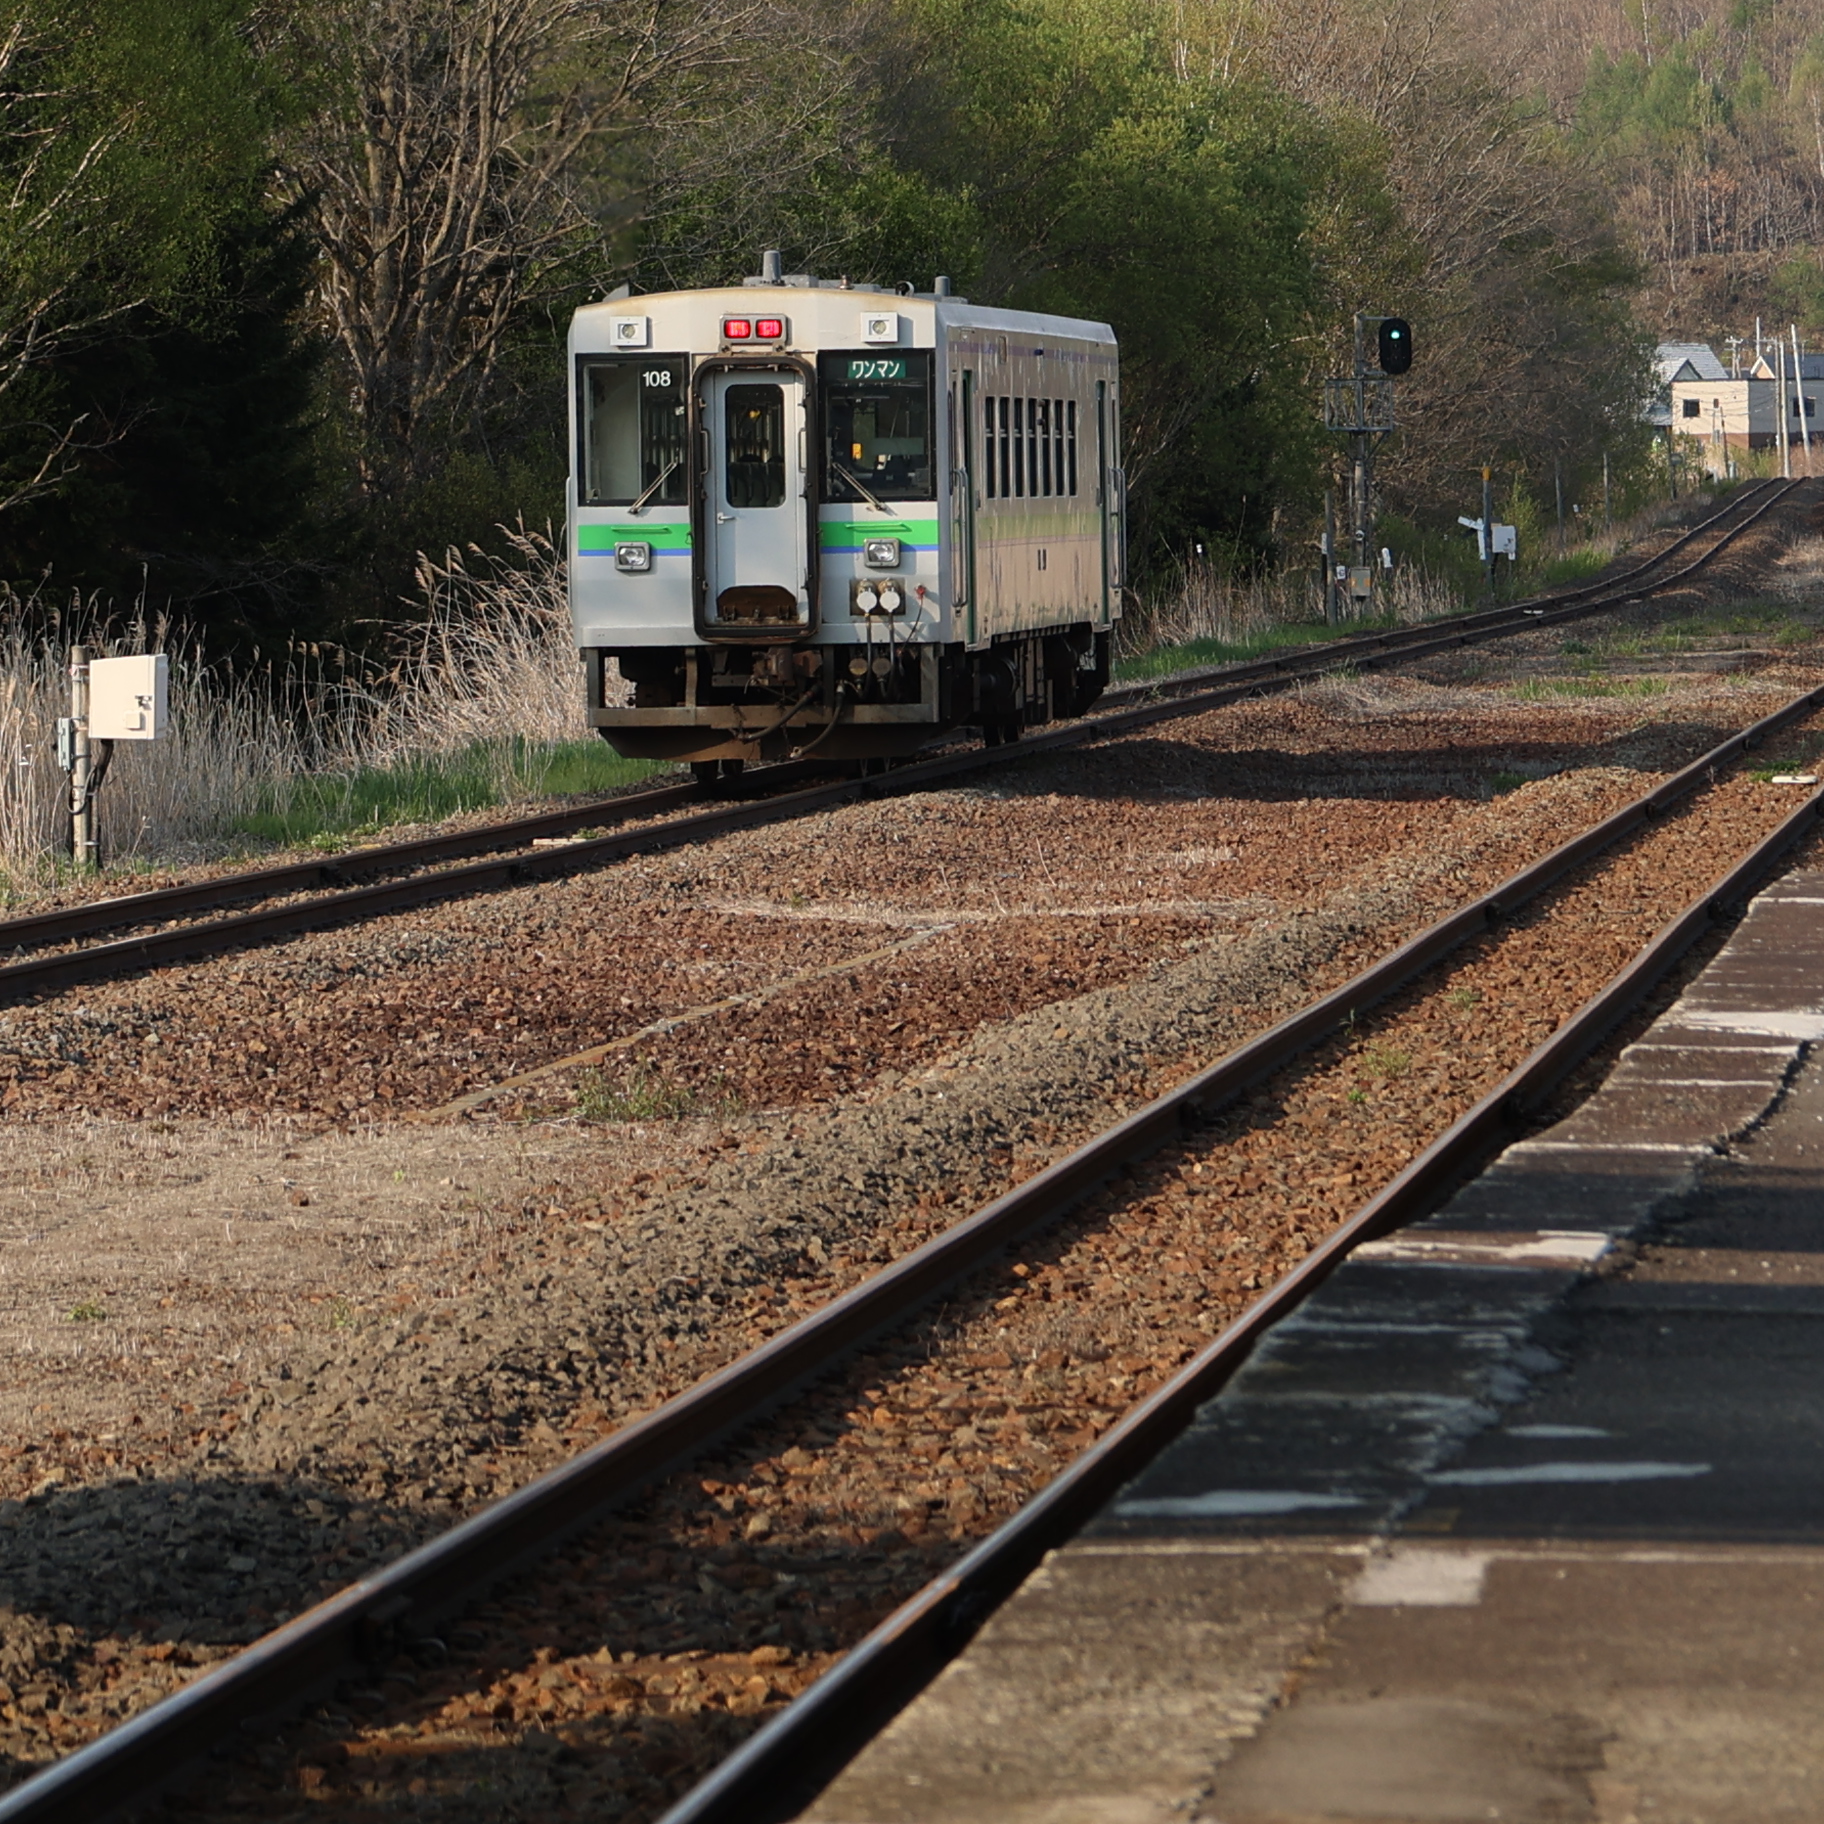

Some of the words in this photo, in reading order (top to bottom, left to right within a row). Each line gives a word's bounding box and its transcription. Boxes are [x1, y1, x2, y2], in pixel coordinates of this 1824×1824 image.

[642, 370, 671, 388] 108
[852, 360, 900, 380] ワンマン
